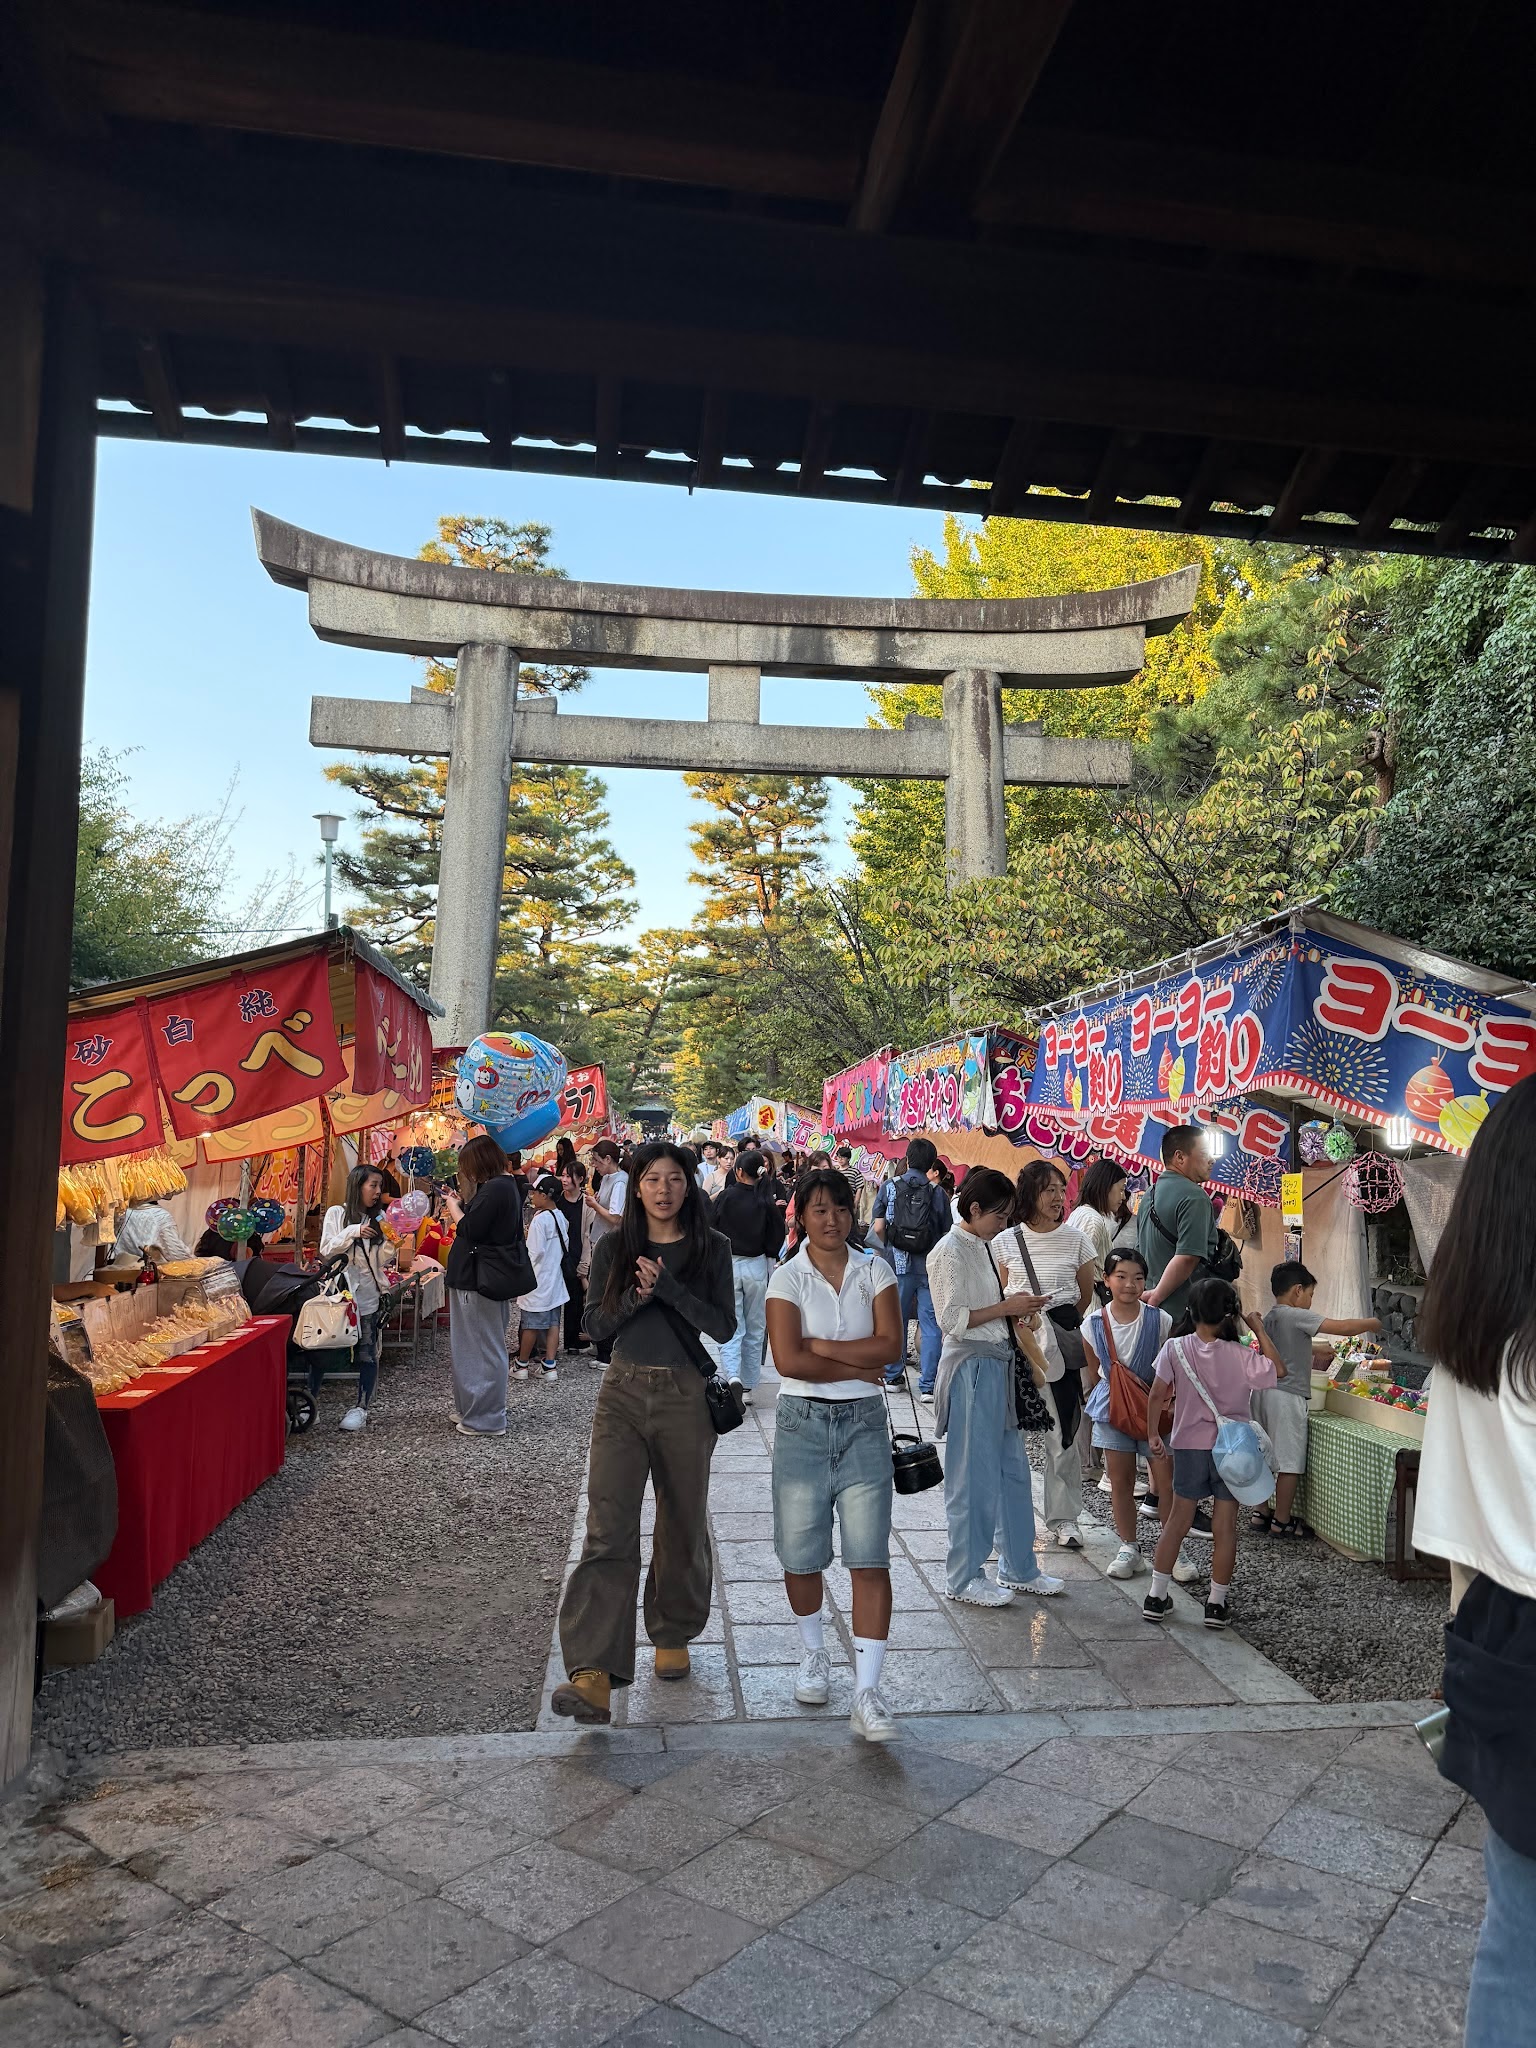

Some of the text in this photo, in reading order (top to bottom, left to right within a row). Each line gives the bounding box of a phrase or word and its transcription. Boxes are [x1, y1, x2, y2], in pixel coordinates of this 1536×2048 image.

[1044, 1014, 1107, 1071] ヨーヨー
[1131, 976, 1234, 1057] ヨーヨー
